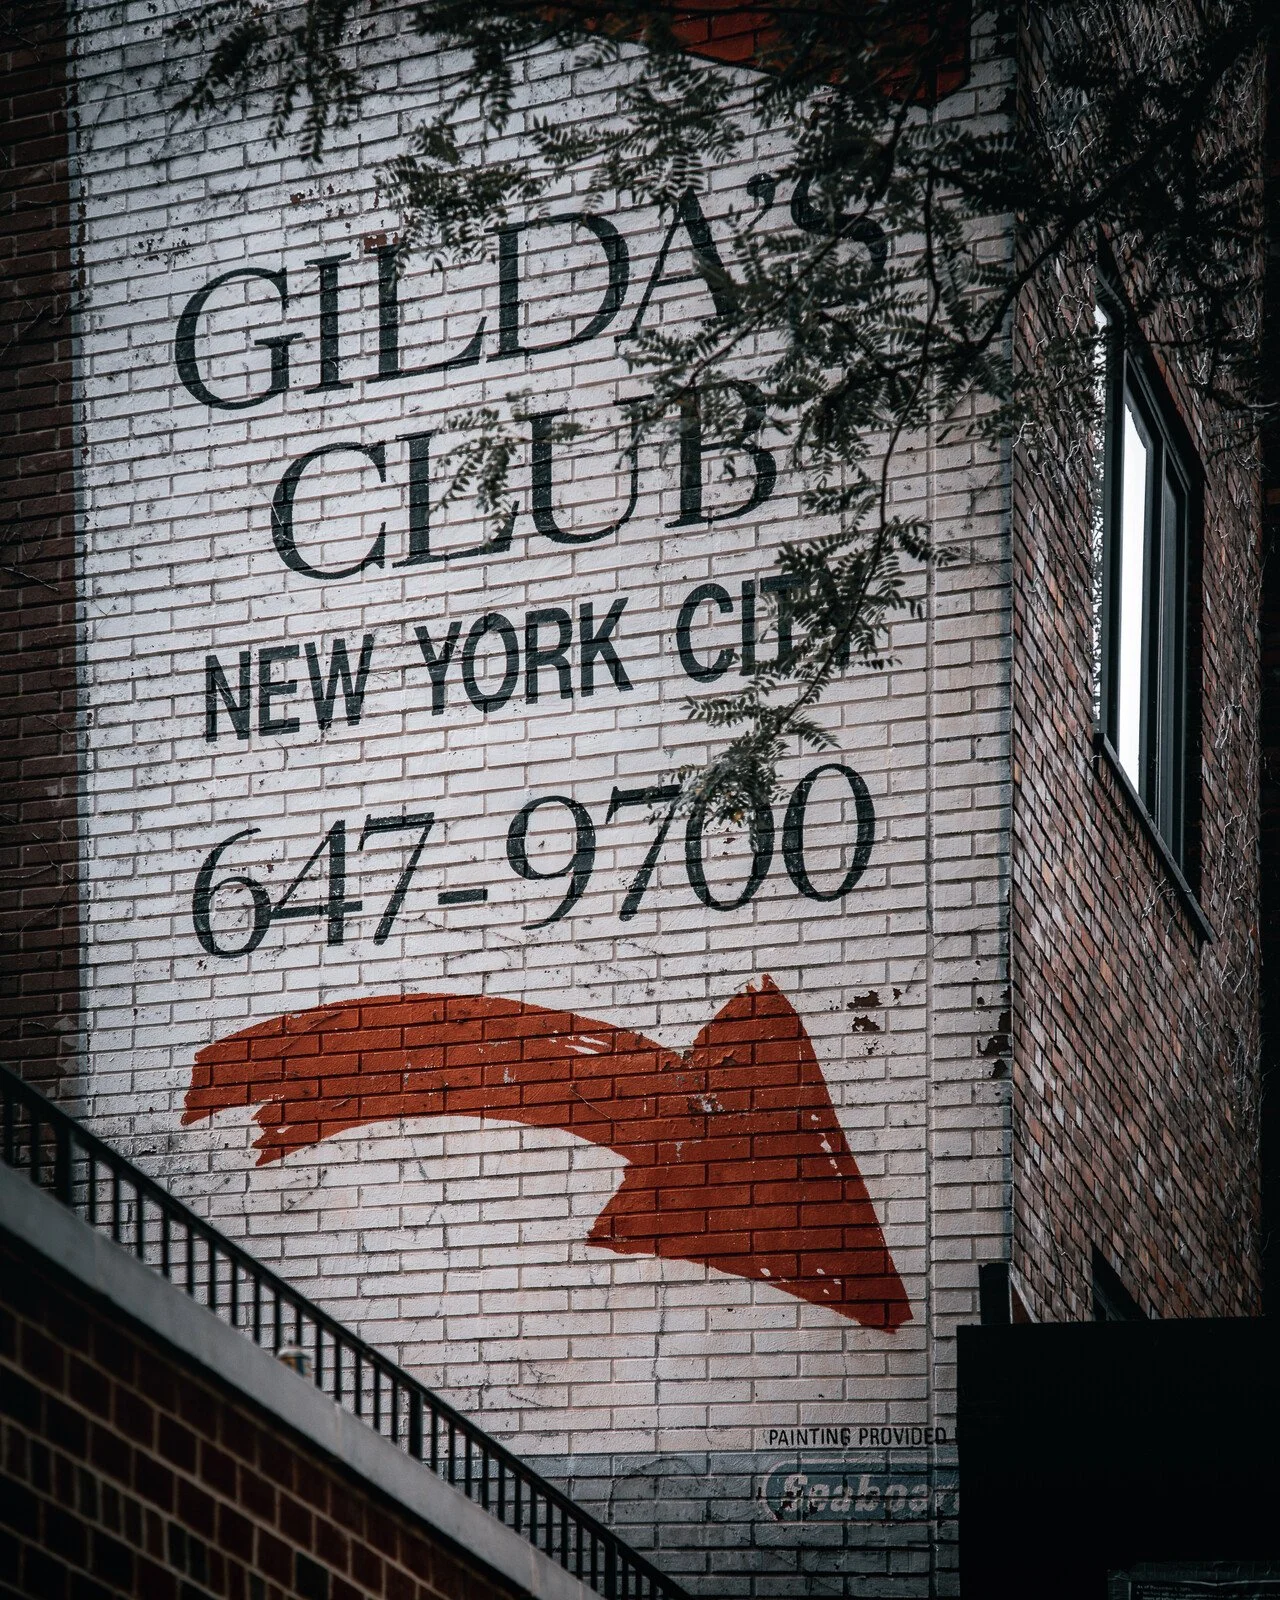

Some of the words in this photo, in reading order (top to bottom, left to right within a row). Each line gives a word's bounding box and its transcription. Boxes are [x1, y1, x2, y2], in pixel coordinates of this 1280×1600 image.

[270, 379, 777, 580] CLUB
[205, 634, 374, 742] NEW
[414, 597, 634, 714] YORK
[676, 566, 868, 684] CIT
[192, 762, 876, 958] 647-9700
[769, 1427, 851, 1447] PAINTING
[859, 1427, 948, 1446] PROVIDED
